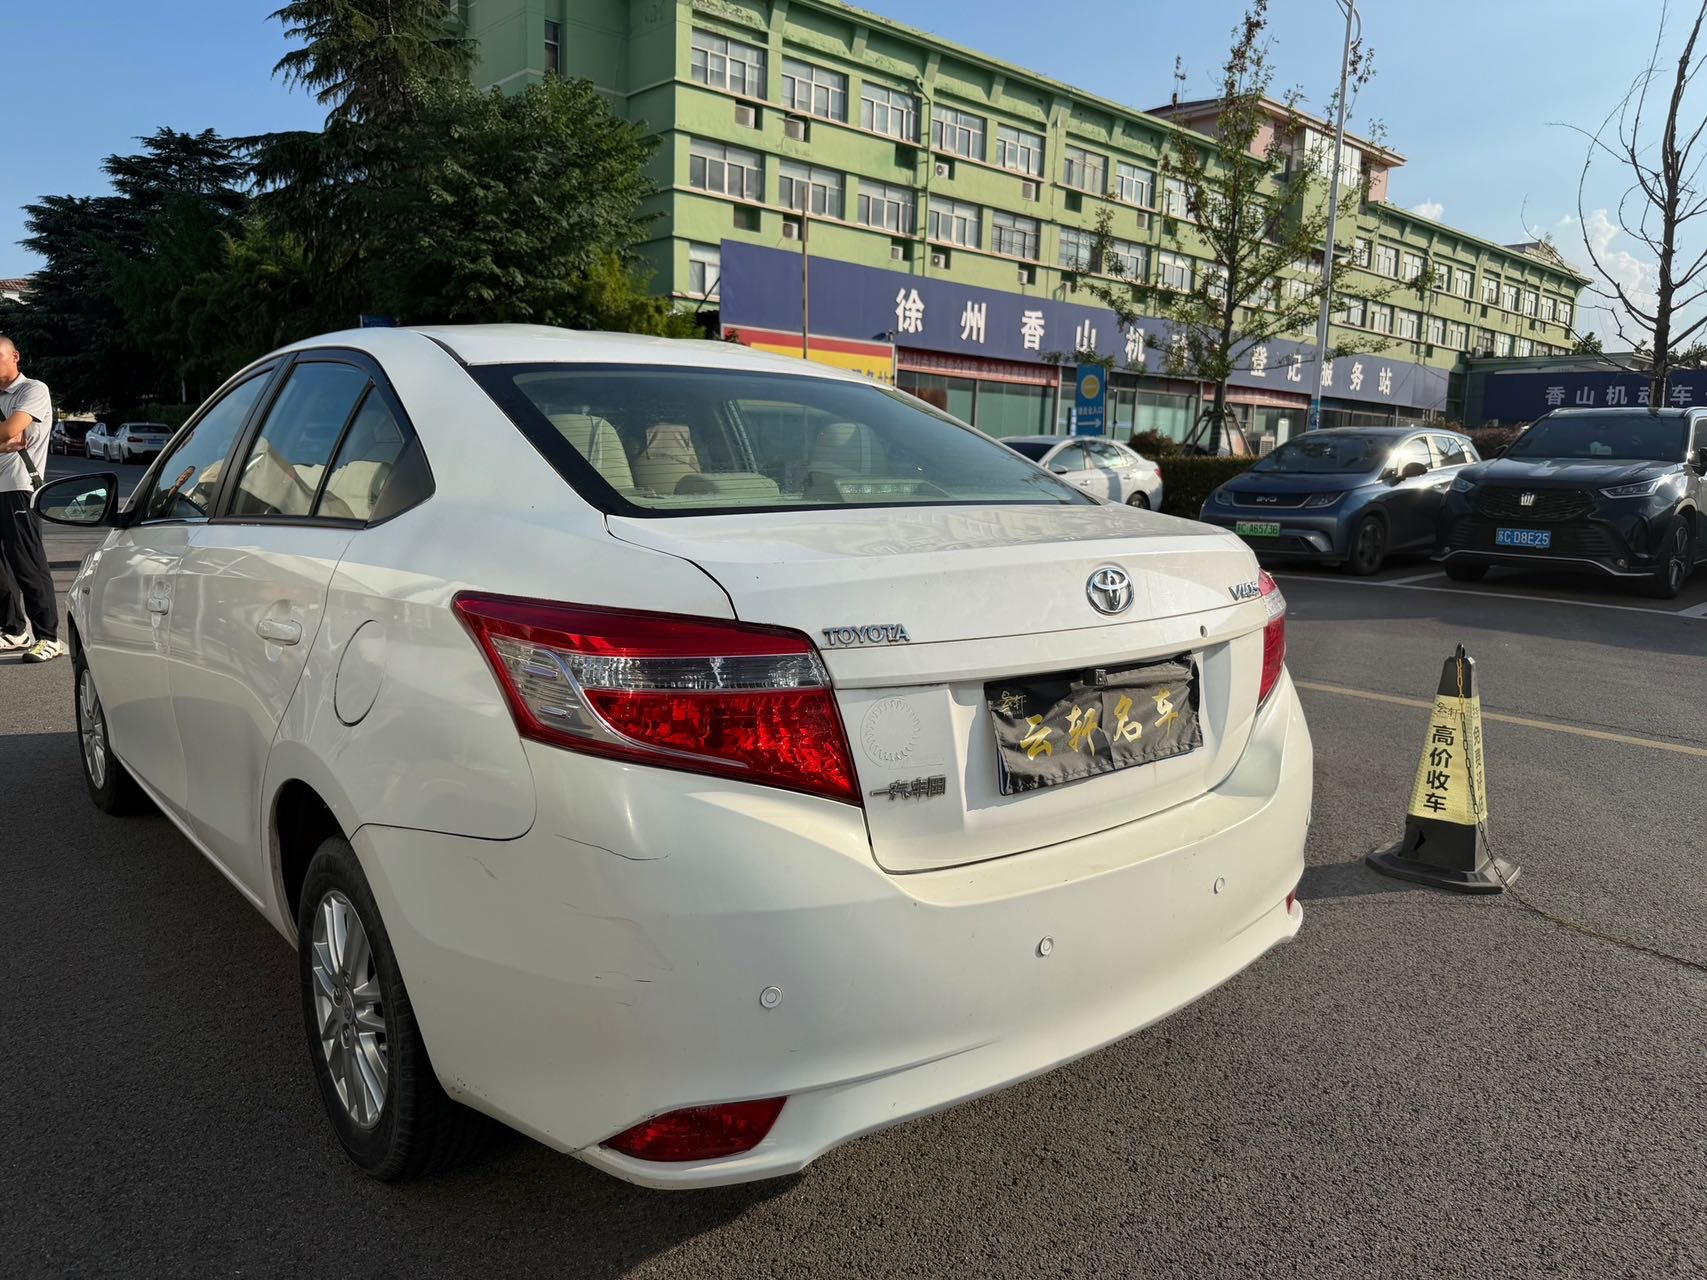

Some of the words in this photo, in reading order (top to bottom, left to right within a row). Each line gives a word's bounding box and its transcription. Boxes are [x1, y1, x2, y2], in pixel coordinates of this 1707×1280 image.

[894, 287, 1393, 396] 徐州香山机登记服务站
[1228, 581, 1259, 601] VIOS
[822, 623, 911, 646] TOYOTA
[1423, 725, 1456, 813] 高价收车
